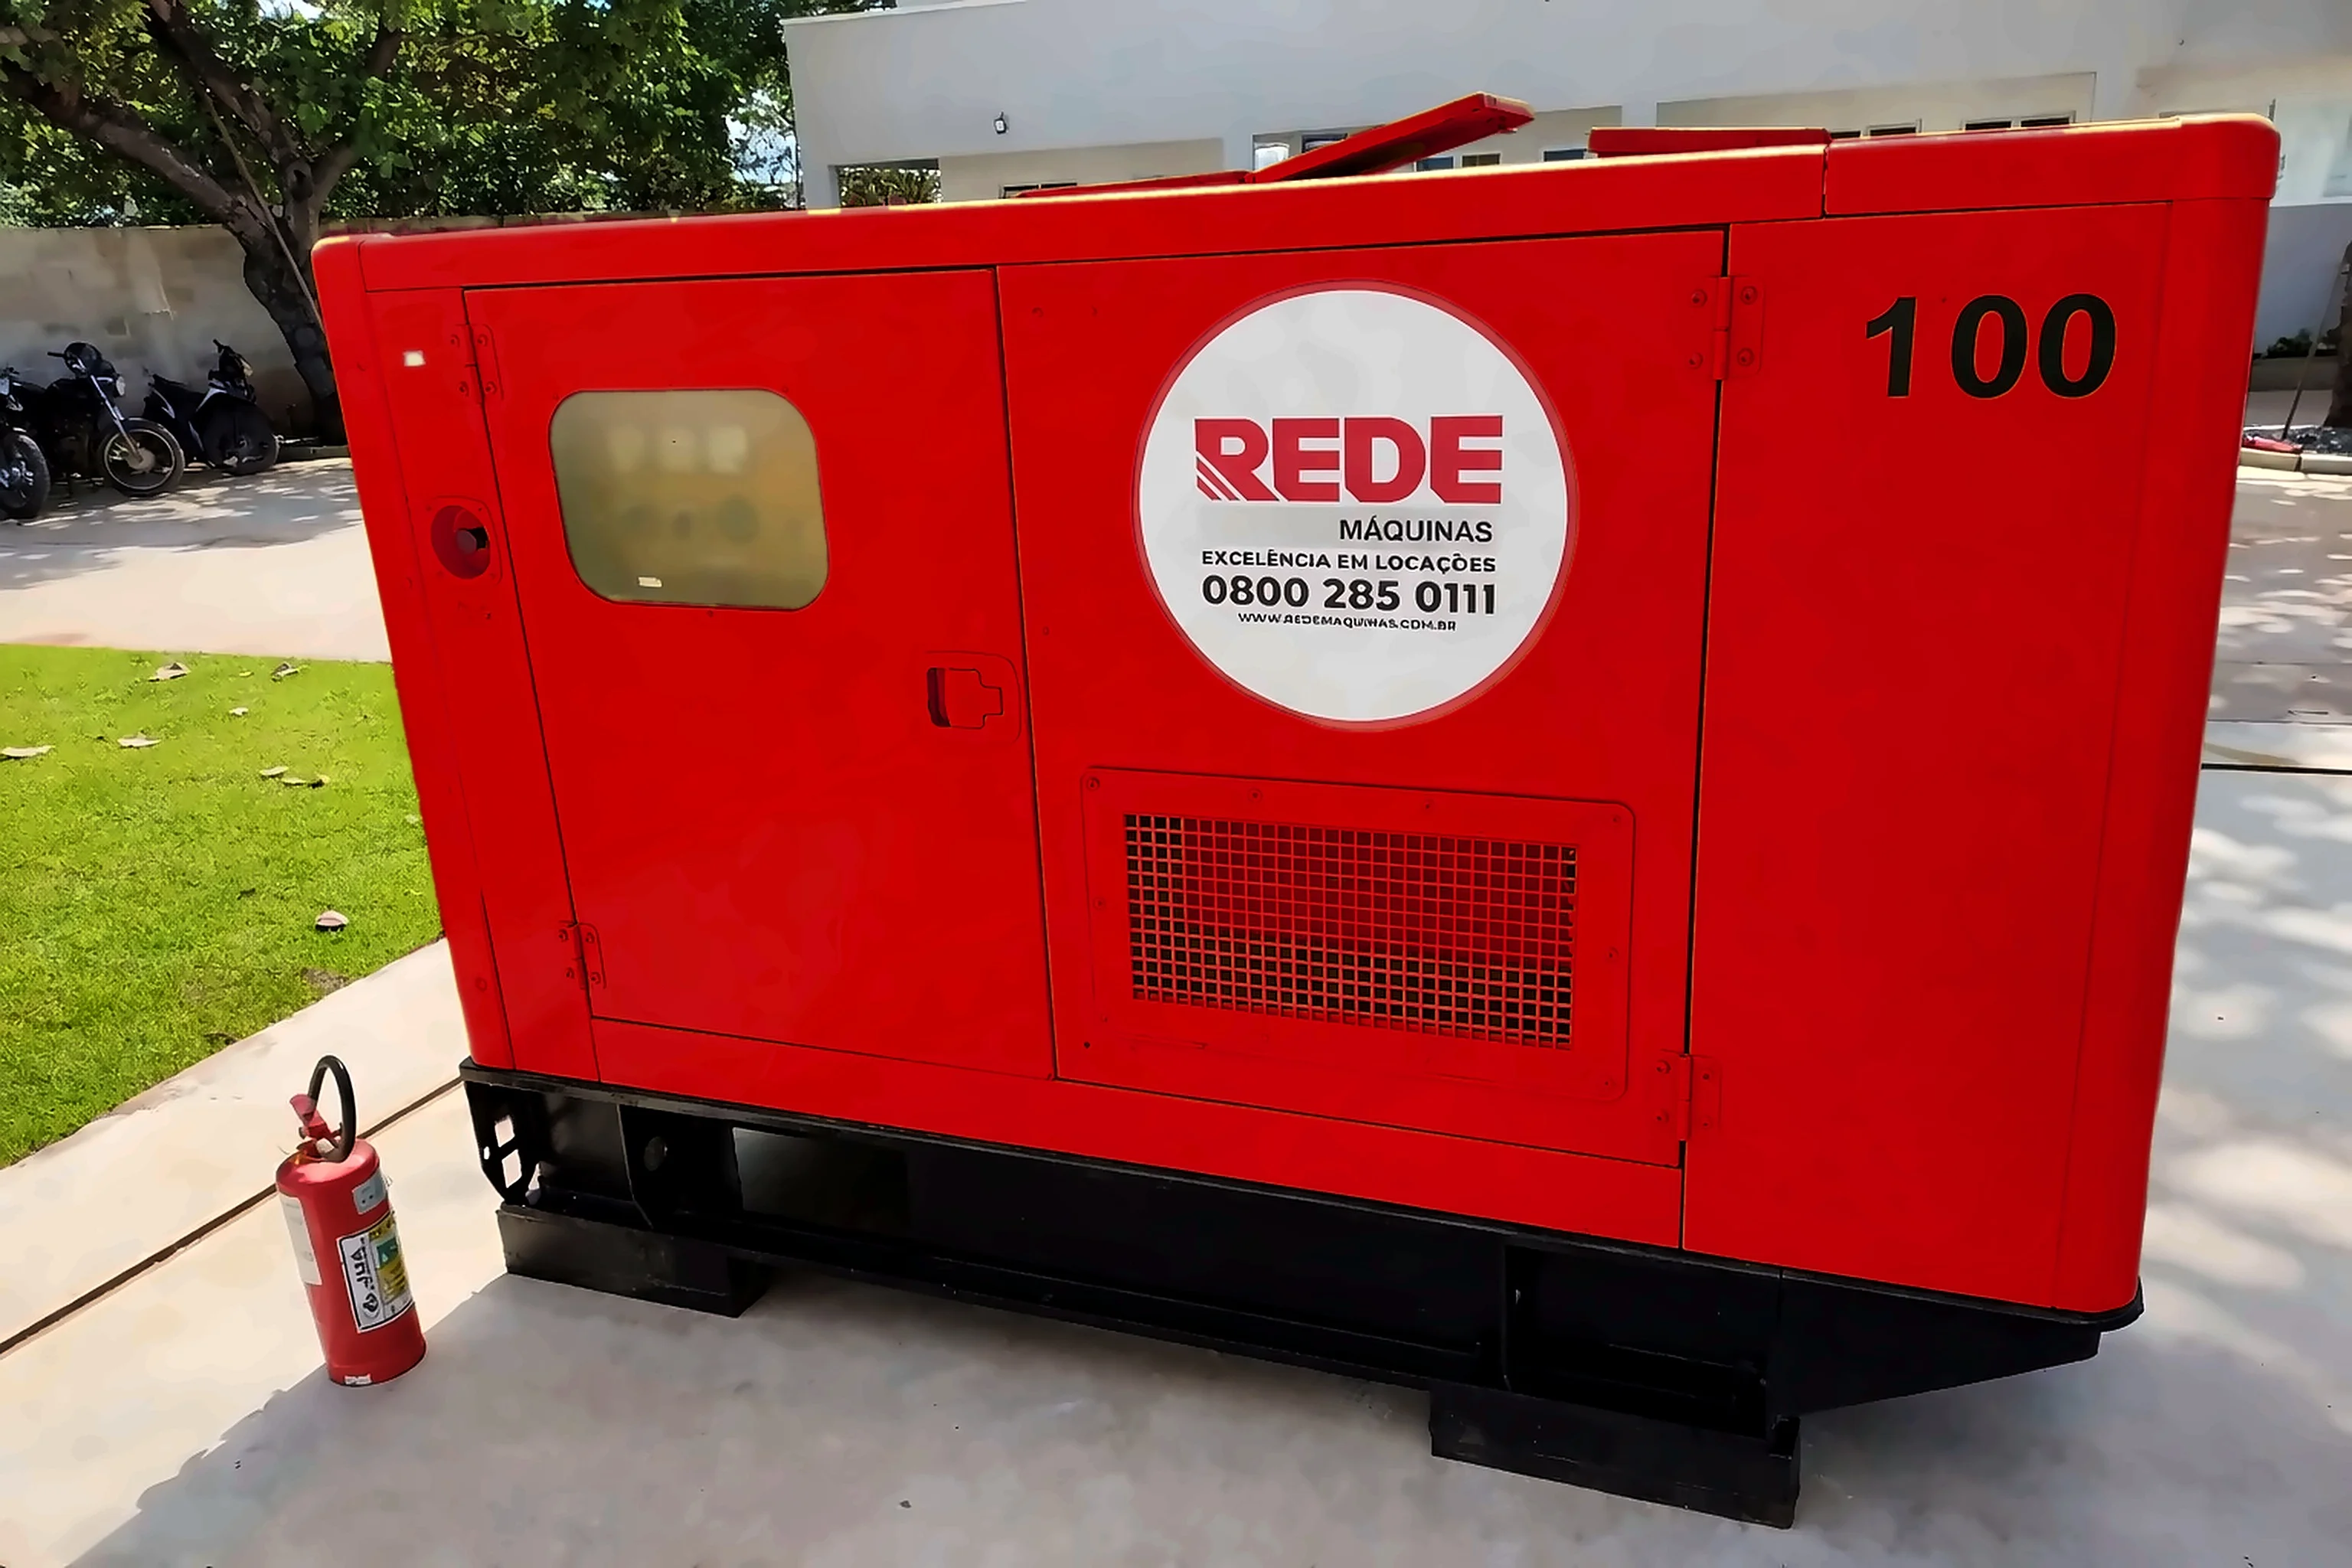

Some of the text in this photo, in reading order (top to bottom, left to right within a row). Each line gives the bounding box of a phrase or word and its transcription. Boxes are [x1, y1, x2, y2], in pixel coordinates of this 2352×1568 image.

[1866, 292, 2117, 399] 100
[1195, 415, 1503, 505] REDE
[1340, 515, 1492, 543] MÁQUINAS
[1202, 549, 1496, 574] EXCELÊNCIA EM LOCAÇÕES
[1202, 574, 1495, 615] 0800 285 0111
